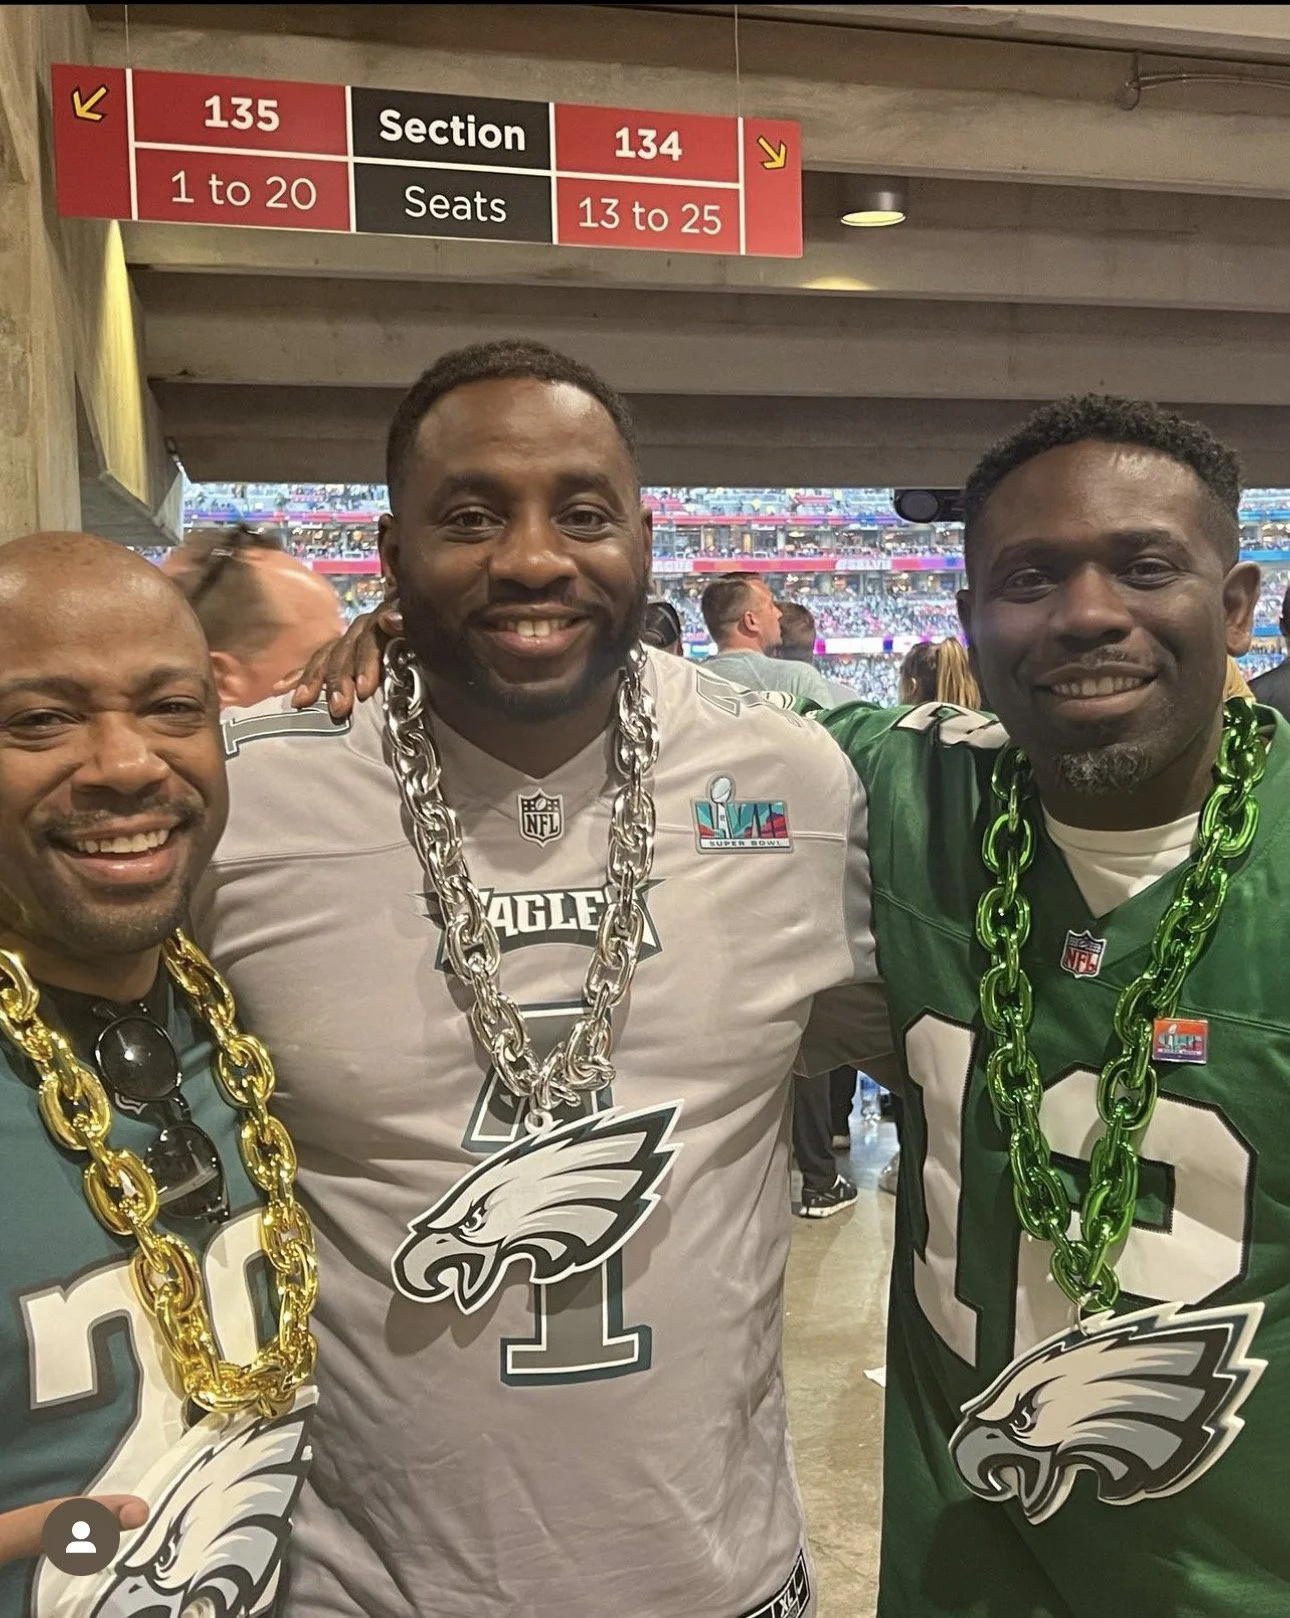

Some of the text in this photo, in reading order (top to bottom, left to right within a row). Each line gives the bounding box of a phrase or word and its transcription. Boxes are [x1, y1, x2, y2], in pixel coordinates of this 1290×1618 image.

[203, 94, 281, 132] 135
[378, 108, 527, 151] Section
[614, 127, 683, 162] 134
[171, 170, 318, 211] 1 to 20
[404, 184, 507, 222] Seats
[578, 196, 722, 235] 13 to 25
[526, 814, 559, 837] NFL
[709, 840, 746, 848] SUPER
[1064, 947, 1097, 974] NFL
